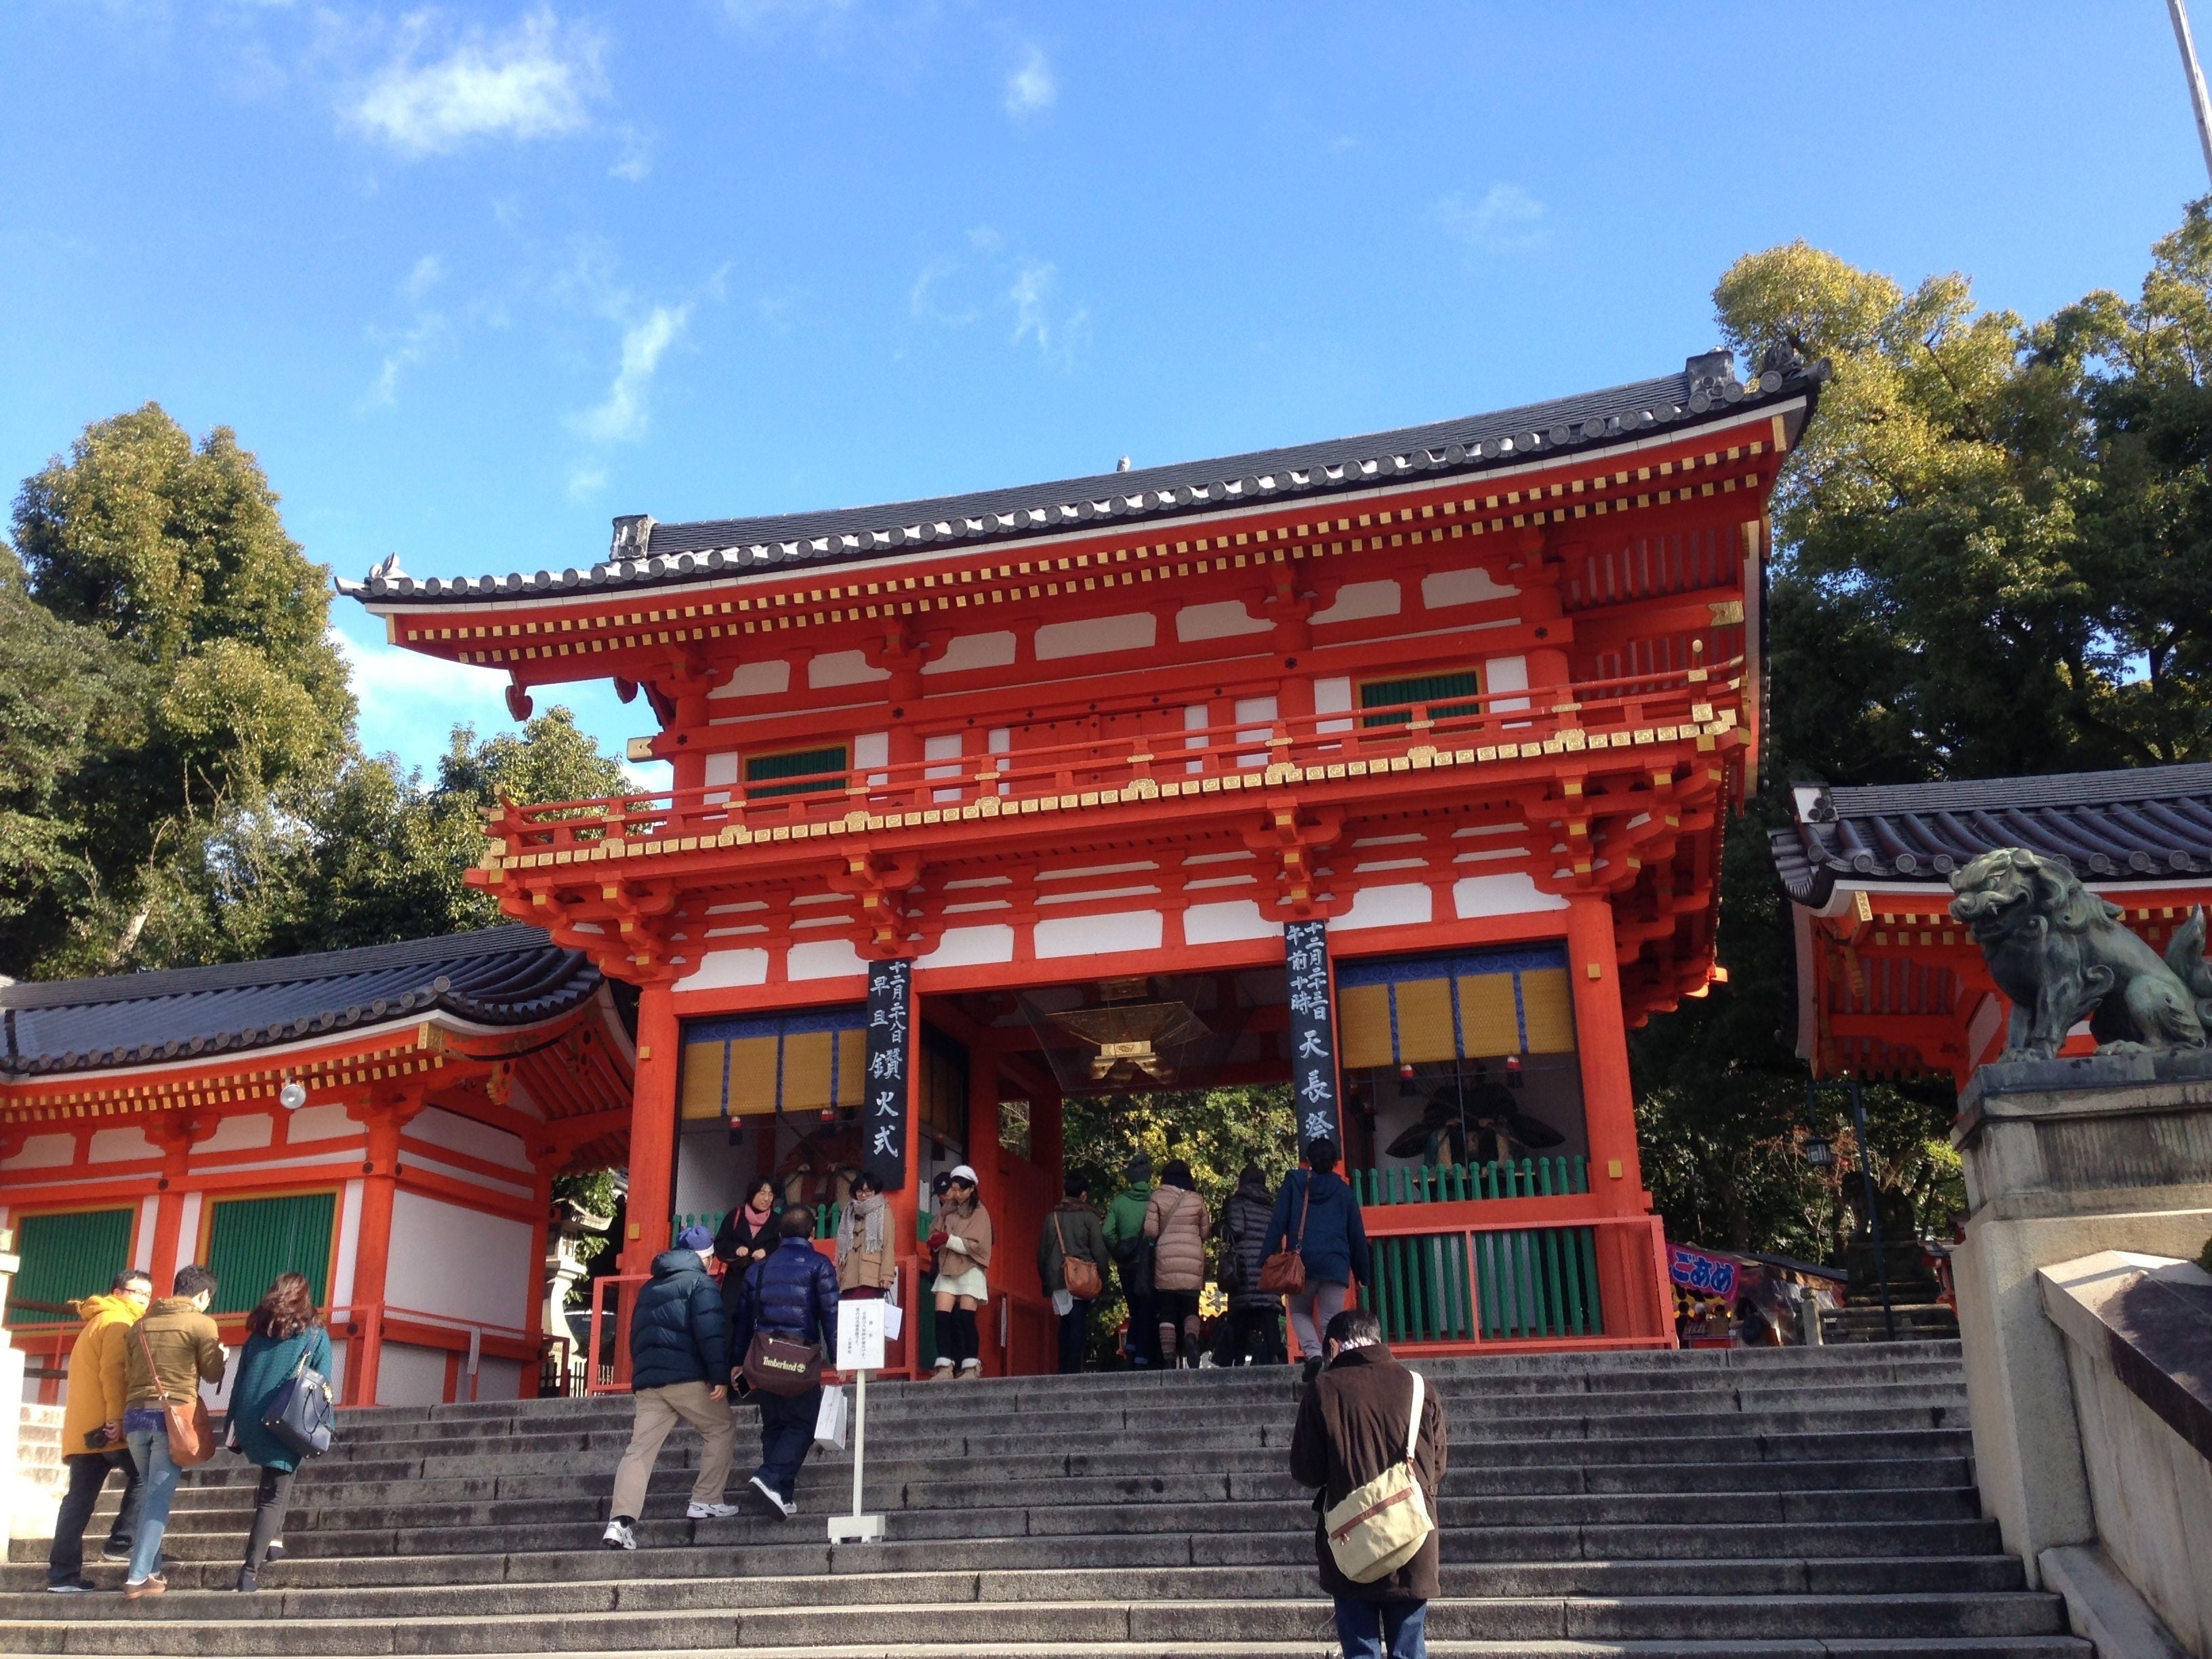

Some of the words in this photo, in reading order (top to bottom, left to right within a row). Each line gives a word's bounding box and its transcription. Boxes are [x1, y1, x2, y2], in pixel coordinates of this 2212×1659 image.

[888, 961, 907, 1043] 十二月二十八日
[1286, 925, 1311, 1015] 午前十時
[1304, 922, 1328, 1021] 十二月二十三日
[1298, 1029, 1334, 1141] 天長祭
[1671, 1250, 1735, 1294] ごあめ
[762, 1356, 798, 1372] Timberland
